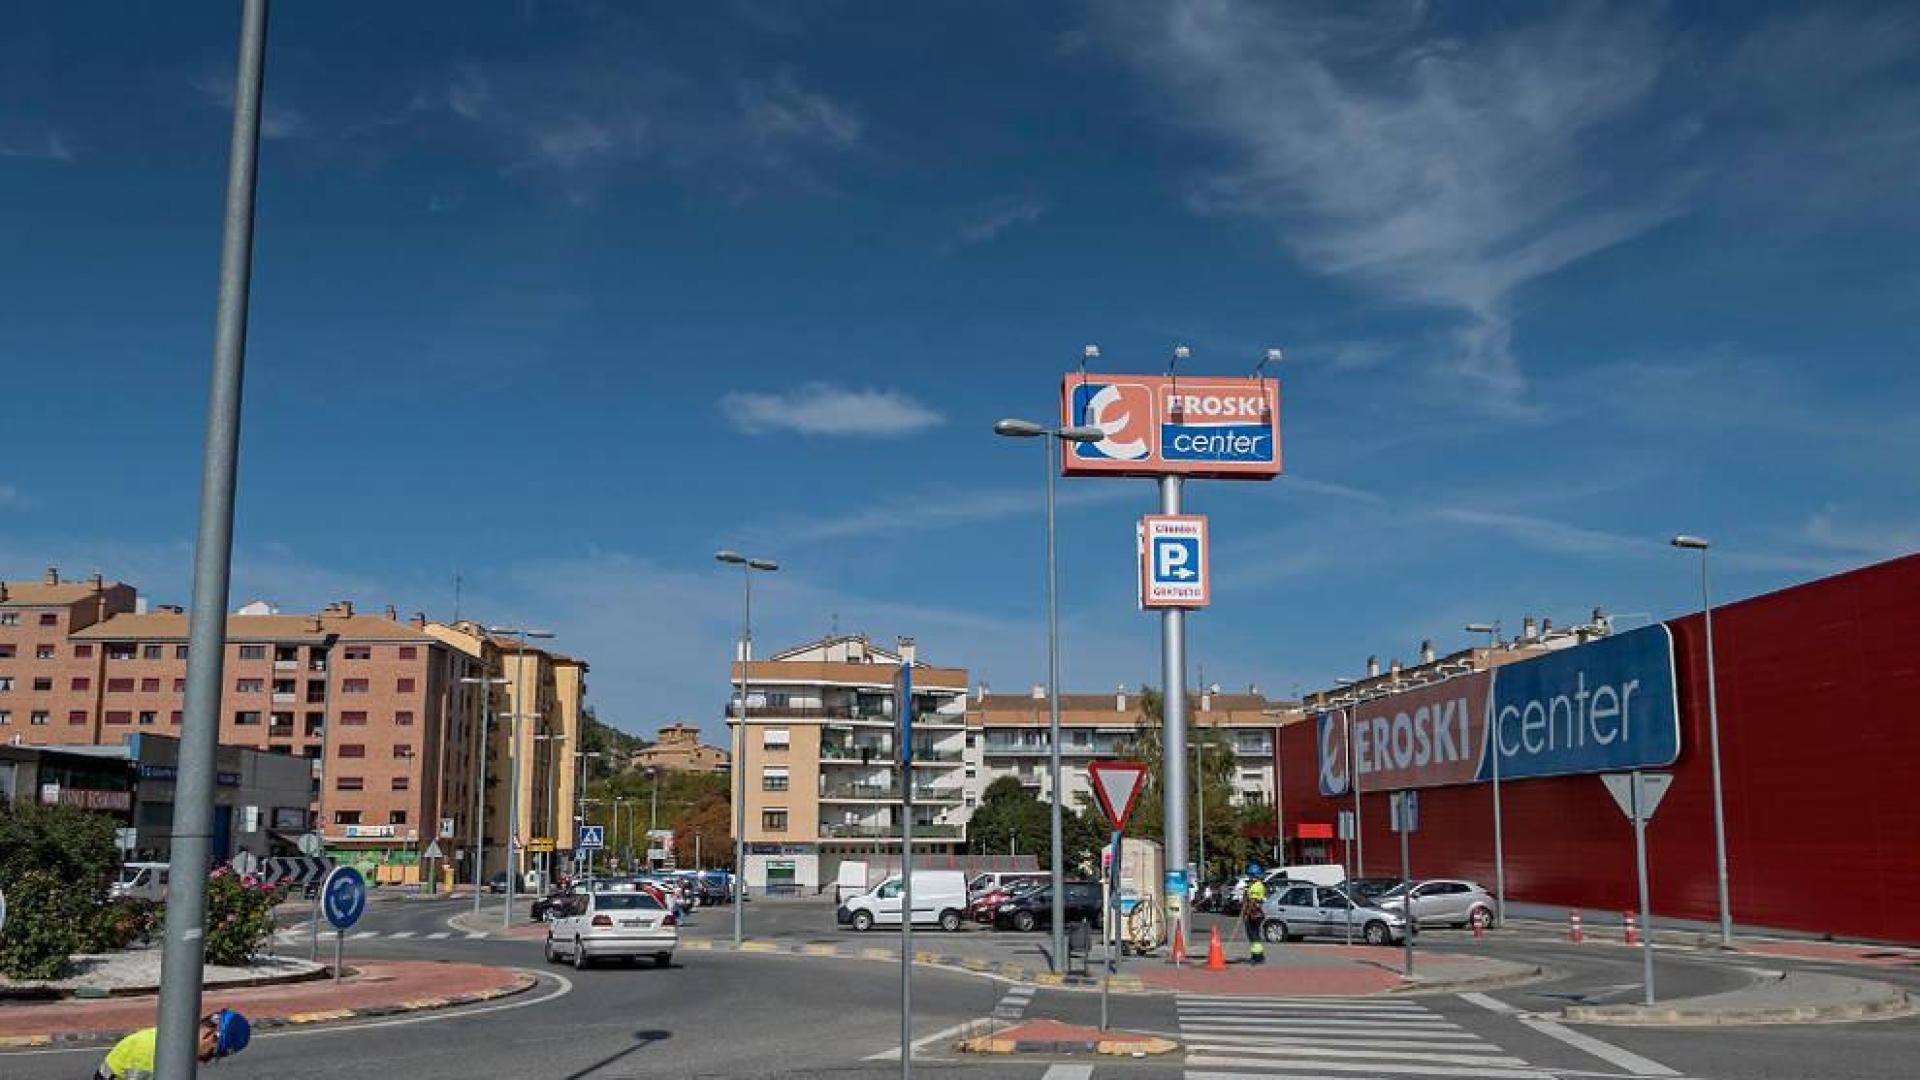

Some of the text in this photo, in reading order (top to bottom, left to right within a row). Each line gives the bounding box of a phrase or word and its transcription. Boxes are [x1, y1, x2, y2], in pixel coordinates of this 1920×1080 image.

[1167, 394, 1267, 417] EROSKI
[1174, 429, 1265, 454] center
[1159, 542, 1188, 576] P
[1354, 670, 1640, 774] EROSKI center
